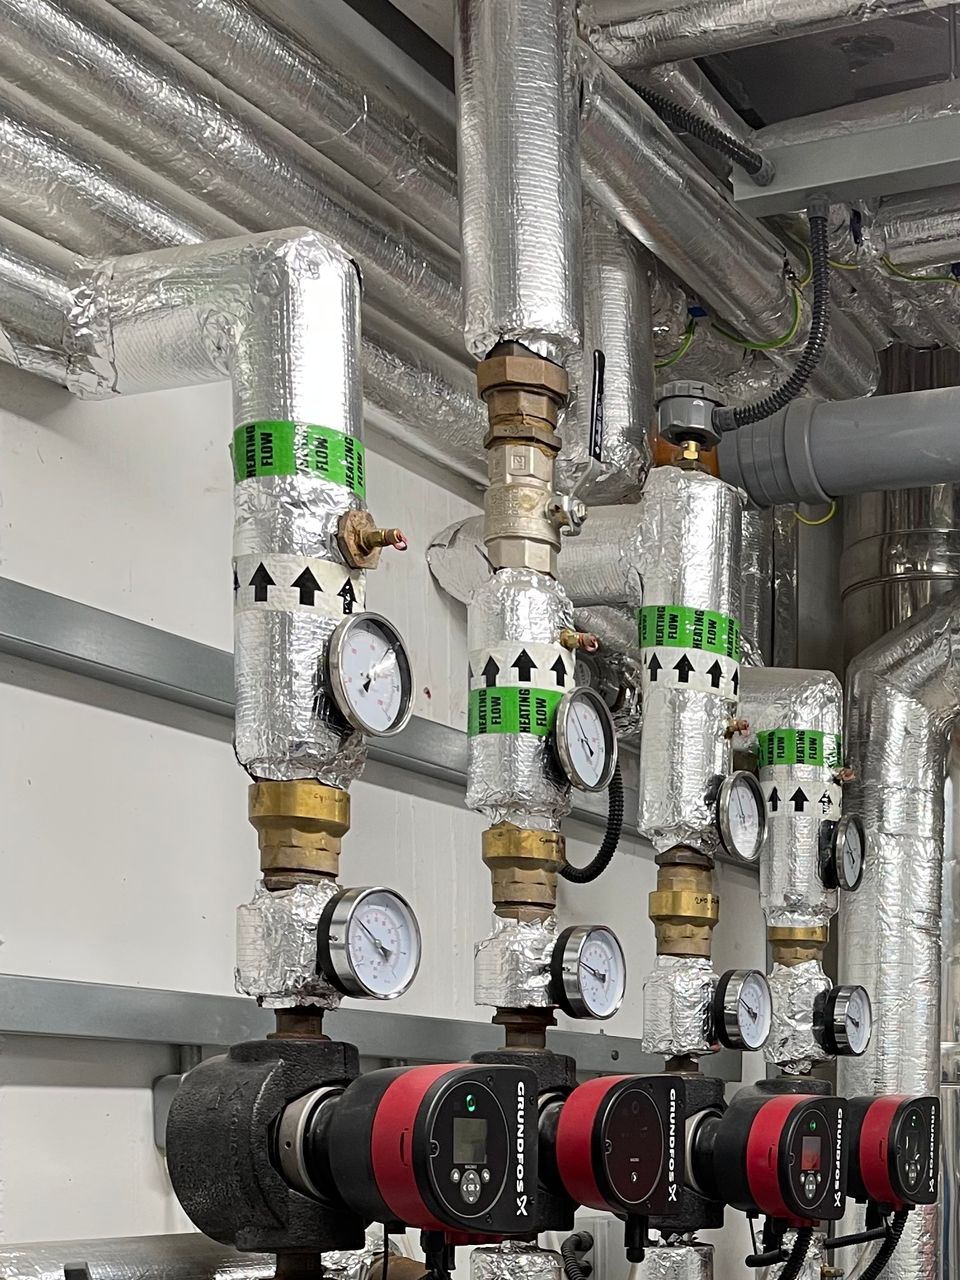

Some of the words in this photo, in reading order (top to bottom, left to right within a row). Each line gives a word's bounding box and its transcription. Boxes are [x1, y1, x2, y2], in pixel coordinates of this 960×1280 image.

[246, 424, 257, 478] HEATING
[261, 432, 274, 467] FLOW
[315, 437, 329, 473] FLOW
[656, 606, 666, 646] HEATING
[668, 613, 679, 639] FLOW
[693, 610, 705, 649] HEATING
[707, 618, 718, 645] FLOW
[727, 618, 735, 658] HEATING
[479, 689, 488, 733] HEATING
[491, 696, 501, 725] FLOW
[519, 688, 531, 733] HEATING
[536, 697, 547, 727] FLOW
[777, 736, 785, 759] FLOW
[796, 730, 806, 765] HEATING
[809, 737, 818, 760] FLOW
[516, 1081, 525, 1193] GRUNDFOS
[668, 1088, 676, 1182] GRUNDFOS
[834, 1107, 843, 1190] GRUNDFOS
